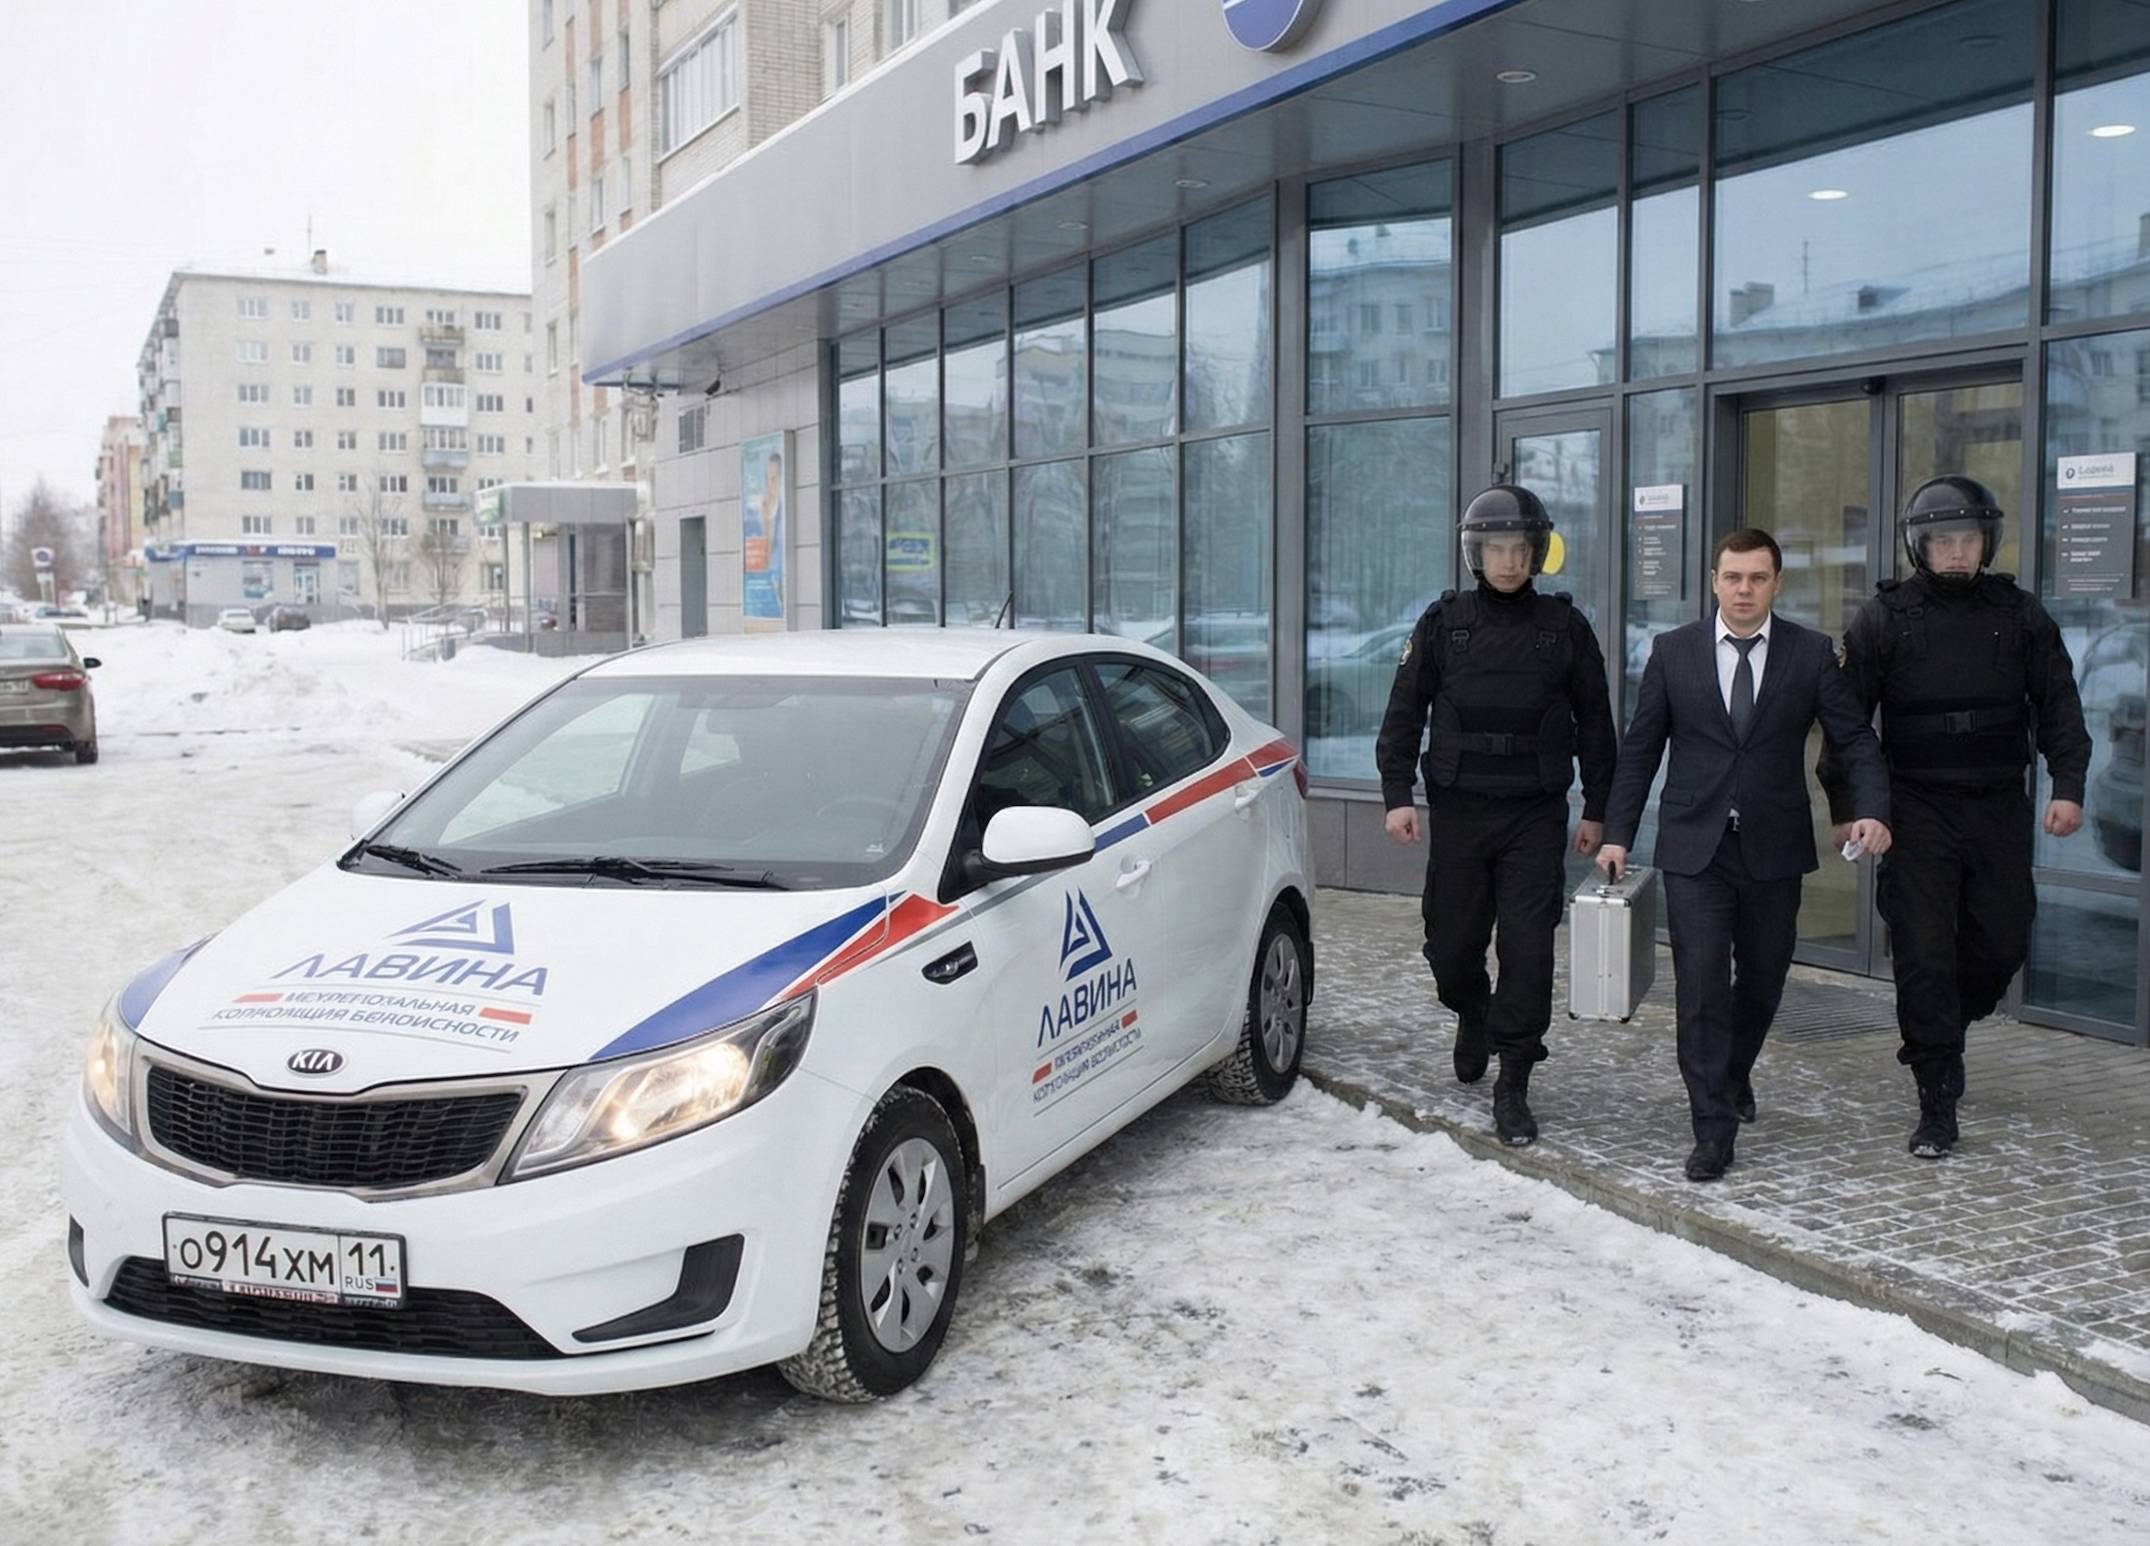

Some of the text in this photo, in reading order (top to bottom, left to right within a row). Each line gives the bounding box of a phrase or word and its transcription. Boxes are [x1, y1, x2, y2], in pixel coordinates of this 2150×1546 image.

[954, 0, 1143, 165] БАНК
[271, 954, 548, 996] ЛАВИНА
[1037, 958, 1137, 1048] ЛАВИНА
[291, 1050, 335, 1071] KIA
[345, 1276, 374, 1290] RUS
